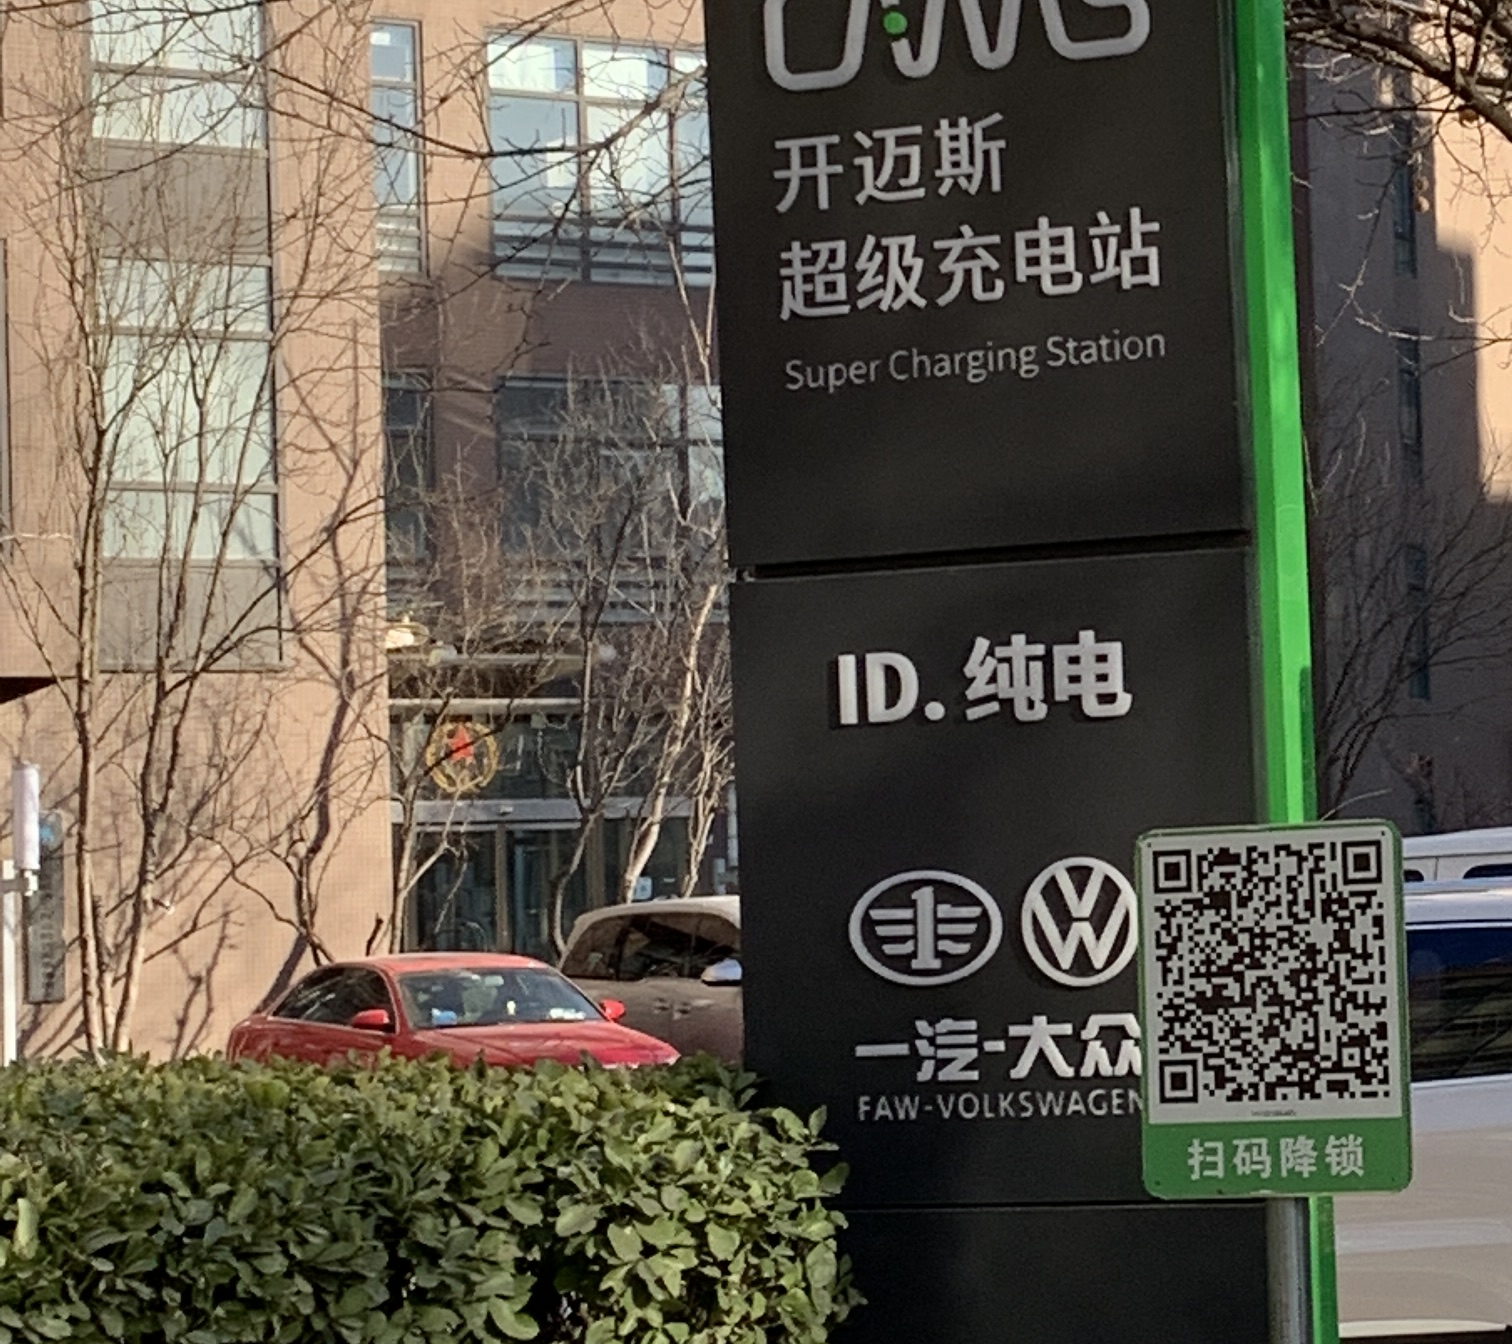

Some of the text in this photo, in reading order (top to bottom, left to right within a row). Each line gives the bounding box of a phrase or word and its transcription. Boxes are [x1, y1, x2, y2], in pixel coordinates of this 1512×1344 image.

[774, 113, 1007, 212] 开迈斯
[779, 206, 1161, 321] 超级充电站
[785, 329, 1166, 393] Super Charging Station
[838, 629, 1133, 726] ID. 纯电
[1186, 1133, 1366, 1181] 扫码降锁
